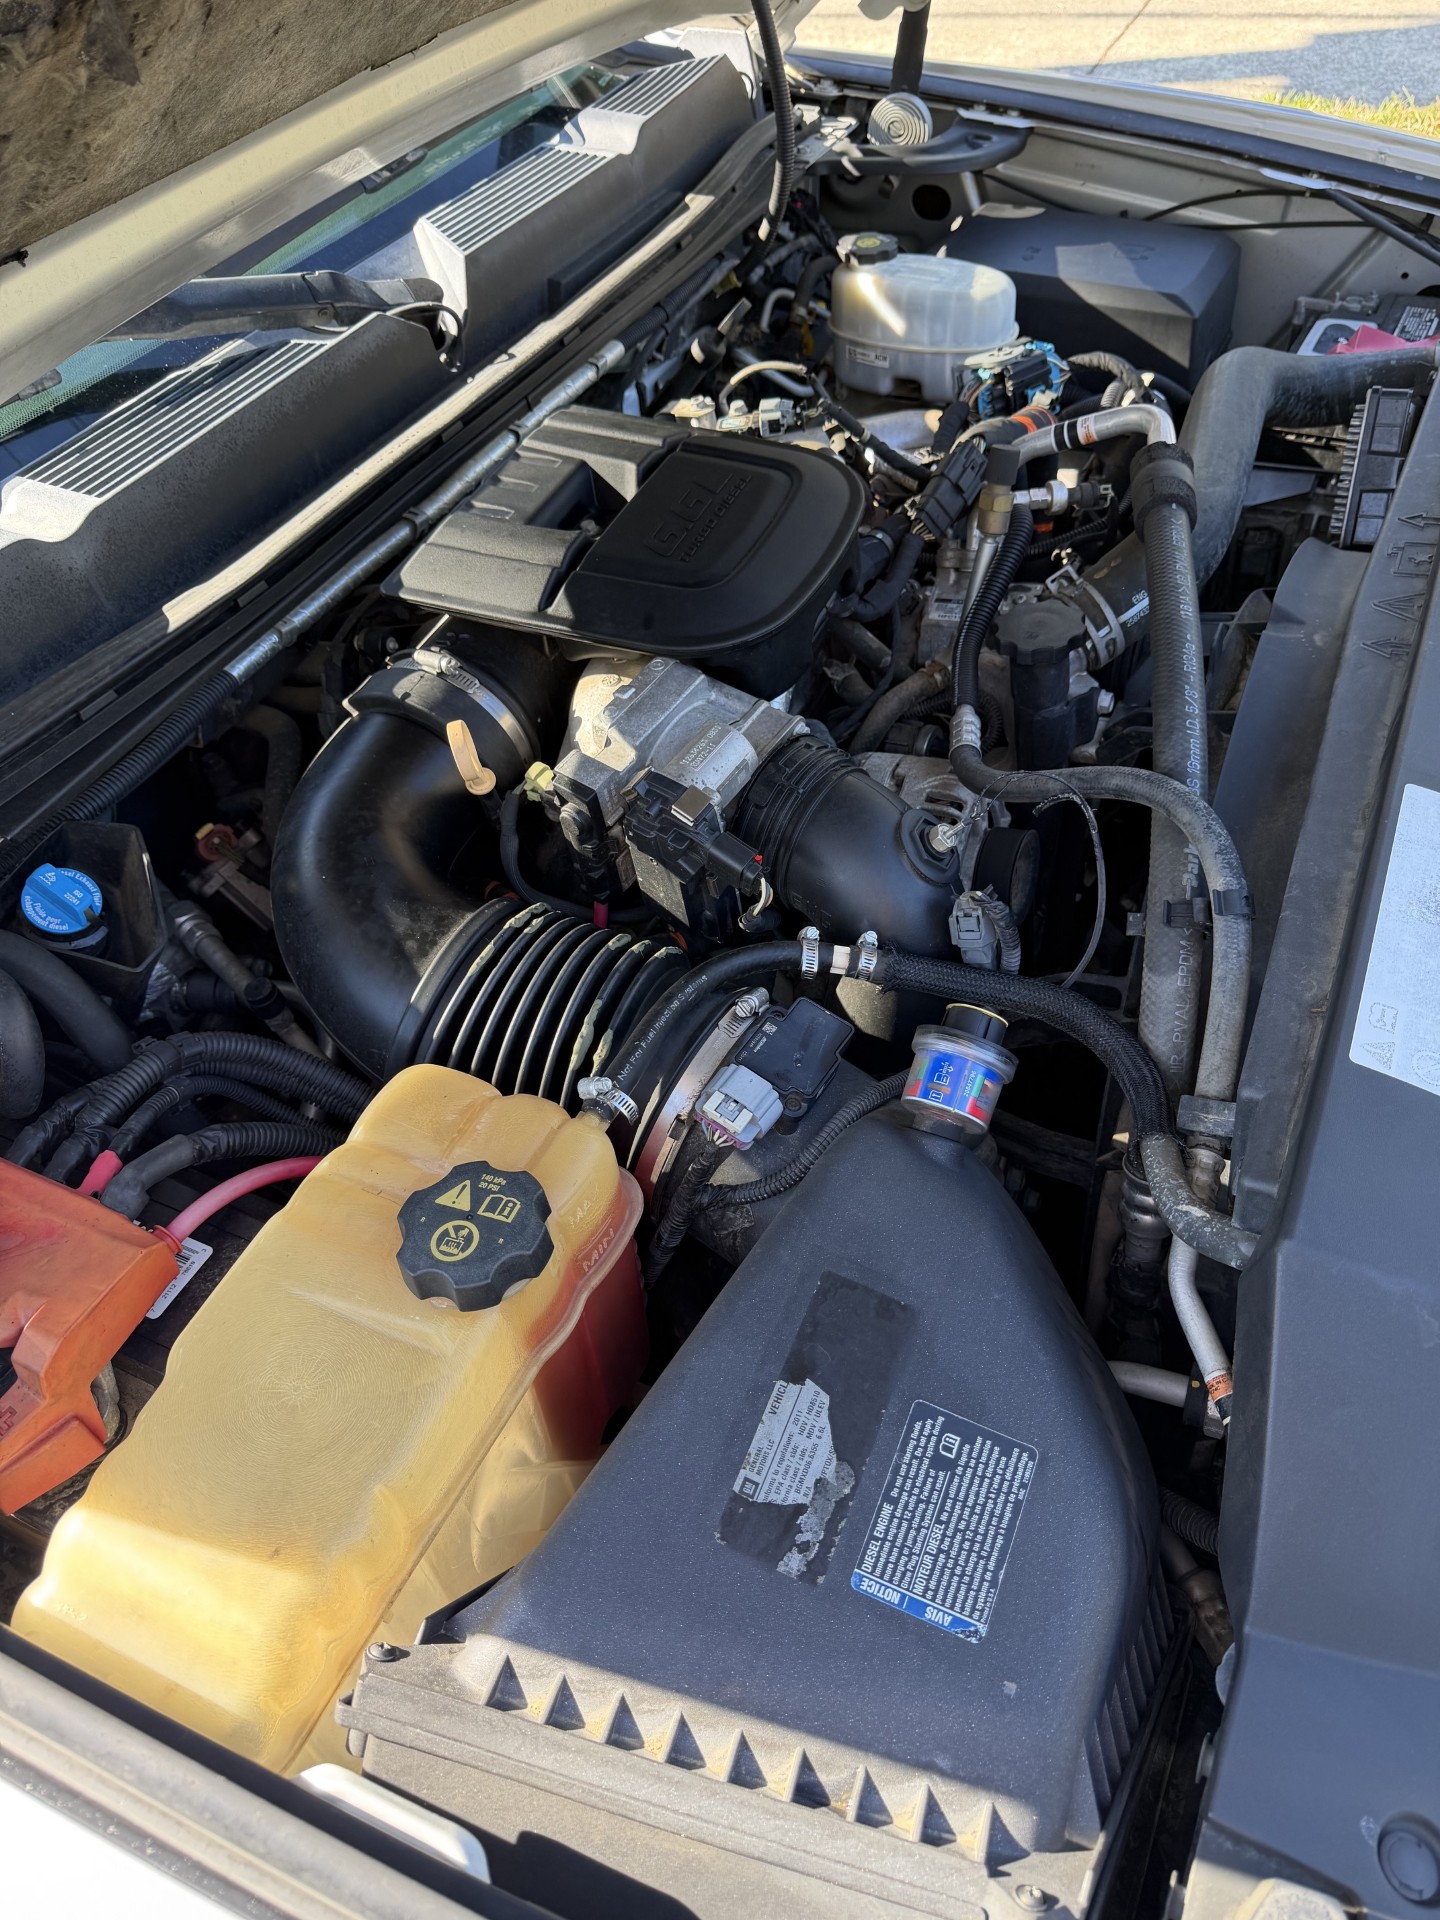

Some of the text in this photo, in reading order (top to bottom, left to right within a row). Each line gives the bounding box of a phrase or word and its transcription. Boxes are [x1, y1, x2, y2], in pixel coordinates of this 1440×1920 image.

[680, 517, 717, 562] TURBO
[1132, 590, 1148, 605] ENG
[1184, 643, 1197, 674] R134a
[1186, 718, 1200, 736] I.D.
[1188, 739, 1201, 774] 16mm
[63, 892, 80, 905] 22241
[73, 889, 83, 897] ISO
[75, 872, 100, 905] Exhaust Fluid
[33, 902, 46, 916] Fluide
[48, 922, 68, 930] diesel
[1177, 940, 1193, 986] EPDM
[618, 975, 707, 1080] Not For Fuel Injection Systems
[481, 1174, 507, 1185] 140 kPa
[487, 1183, 500, 1191] PSI
[162, 1282, 176, 1299] 21112
[777, 1433, 794, 1468] regulations:
[793, 1410, 802, 1426] 2011
[790, 1467, 800, 1483] class
[799, 1448, 807, 1461] stds:
[806, 1423, 816, 1439] MDV
[814, 1400, 825, 1418] ULEV
[972, 1436, 982, 1458] moteur
[749, 1447, 763, 1472] GENERAL
[756, 1439, 774, 1476] MOTORS LLC
[774, 1482, 784, 1495] EPA
[782, 1464, 791, 1480] class
[790, 1443, 799, 1458] stds:
[798, 1421, 807, 1435] HDV
[958, 1444, 970, 1465] liquide
[969, 1459, 976, 1467] au
[956, 1467, 963, 1475] de
[803, 1487, 812, 1498] N/A
[862, 1541, 881, 1572] DIESEL
[874, 1503, 893, 1538] ENGINE
[891, 1488, 899, 1497] Do
[899, 1464, 907, 1476] use
[903, 1440, 916, 1463] starting
[911, 1421, 922, 1439] fluids.
[873, 1419, 933, 1576] Immediate engine damage can result. Do not apply
[884, 1564, 894, 1580] more
[889, 1548, 899, 1562] than
[895, 1520, 908, 1547] nominal
[904, 1511, 911, 1519] 12
[908, 1496, 917, 1510] volts
[916, 1458, 929, 1486] electrical
[926, 1436, 937, 1457] system
[933, 1416, 944, 1435] during
[920, 1478, 933, 1500] Failure
[949, 1476, 960, 1498] utiliser
[940, 1512, 948, 1521] Ne
[946, 1502, 962, 1536] dommages
[975, 1505, 981, 1513] au
[901, 1471, 945, 1588] Glow Plug Starting System can result.
[905, 1503, 925, 1547] jump-starting.
[935, 1569, 951, 1604] pourraient
[947, 1559, 954, 1568] en
[958, 1521, 966, 1529] Ne
[967, 1476, 980, 1506] appliquer
[980, 1441, 991, 1463] tension
[969, 1515, 978, 1530] volts
[926, 1524, 945, 1554] DIESEL
[941, 1537, 950, 1550] Des
[954, 1584, 967, 1612] pendant
[966, 1553, 977, 1575] charge
[973, 1543, 980, 1551] ou
[990, 1475, 1001, 1492] l'aide
[997, 1457, 1006, 1474] d'une
[963, 1541, 970, 1549] de
[965, 1531, 973, 1539] 12
[903, 1547, 909, 1555] or
[958, 1551, 967, 1565] plus
[972, 1611, 980, 1620] du
[984, 1572, 992, 1580] de
[1000, 1503, 1013, 1528] bougies
[1008, 1494, 1016, 1502] de
[893, 1556, 908, 1584] charging
[913, 1555, 934, 1595] MOTEUR
[955, 1566, 962, 1575] de
[962, 1591, 976, 1615] batterie
[972, 1559, 986, 1590] auxiliaire.
[984, 1526, 995, 1551] pourrait
[992, 1517, 998, 1525] en
[860, 1573, 900, 1605] NOTICE
[926, 1591, 933, 1599] de
[945, 1576, 959, 1607] nominale
[925, 1607, 953, 1628] AVIS
